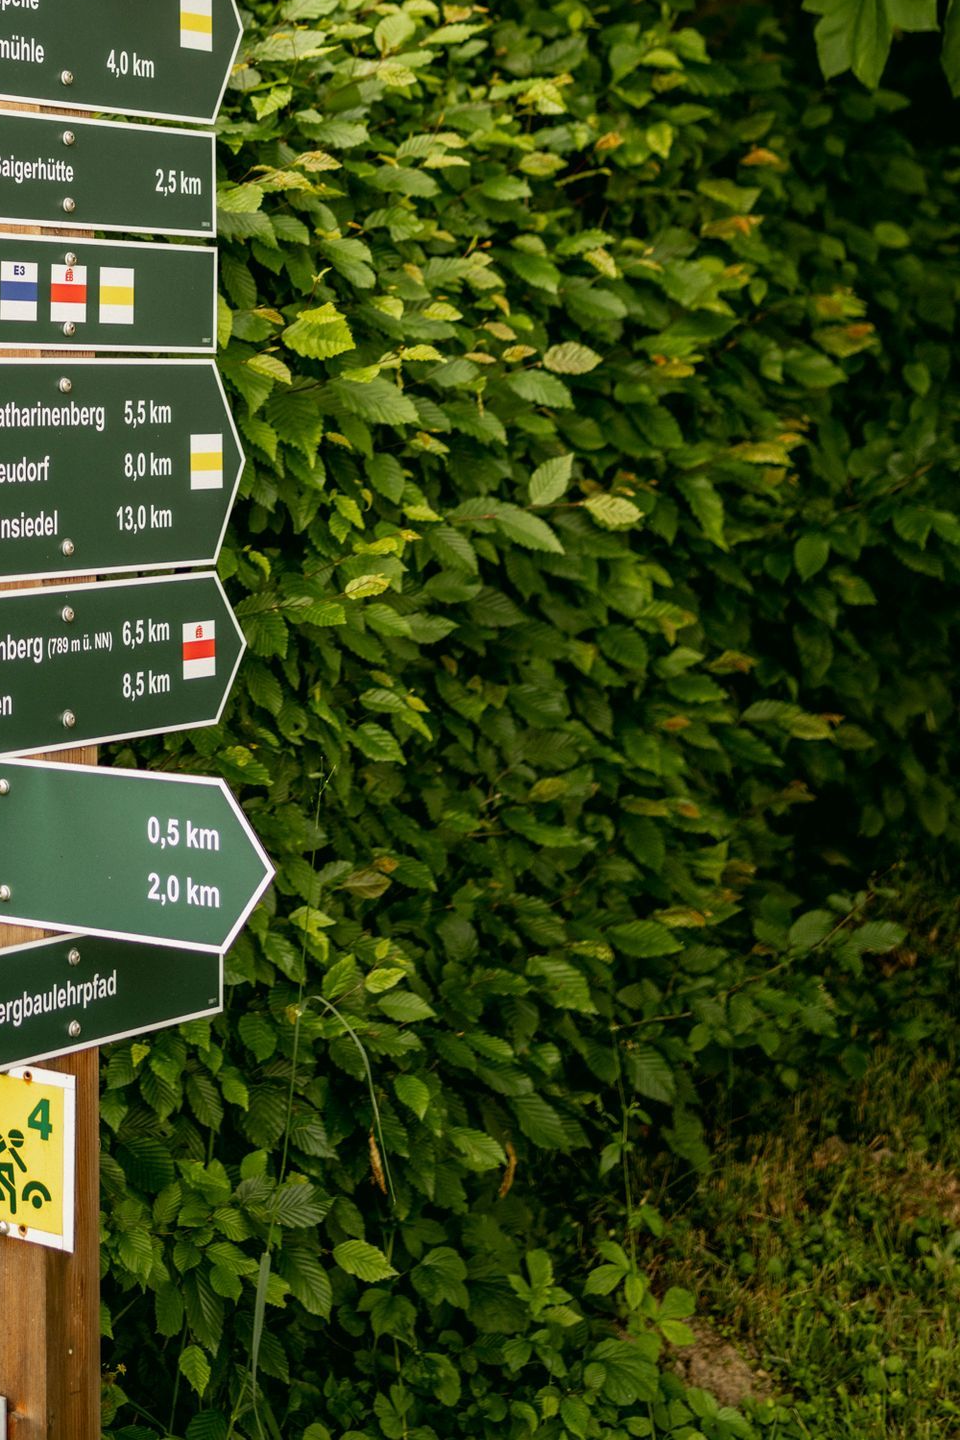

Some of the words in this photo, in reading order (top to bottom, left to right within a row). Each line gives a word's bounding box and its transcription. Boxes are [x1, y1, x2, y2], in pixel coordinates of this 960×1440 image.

[106, 50, 128, 76] 4,0
[132, 53, 155, 78] km
[155, 169, 176, 196] 2,5
[180, 171, 201, 195] km
[14, 265, 25, 276] E3
[124, 400, 145, 427] 5,5
[150, 400, 172, 423] km
[124, 453, 146, 480] 8,0
[150, 452, 172, 476] km
[117, 506, 146, 533] 13,0
[150, 505, 172, 529] km
[47, 638, 68, 659] (789
[71, 641, 80, 653] m
[83, 636, 92, 651] ü.
[94, 632, 113, 652] NN)
[122, 621, 144, 650] 6,5
[148, 619, 170, 643] km
[123, 673, 144, 701] 8,5
[148, 670, 170, 694] km
[147, 816, 180, 849] 0,5
[186, 820, 219, 851] km
[147, 873, 180, 906] 2,0
[187, 876, 220, 908] km
[28, 1099, 53, 1141] 4
